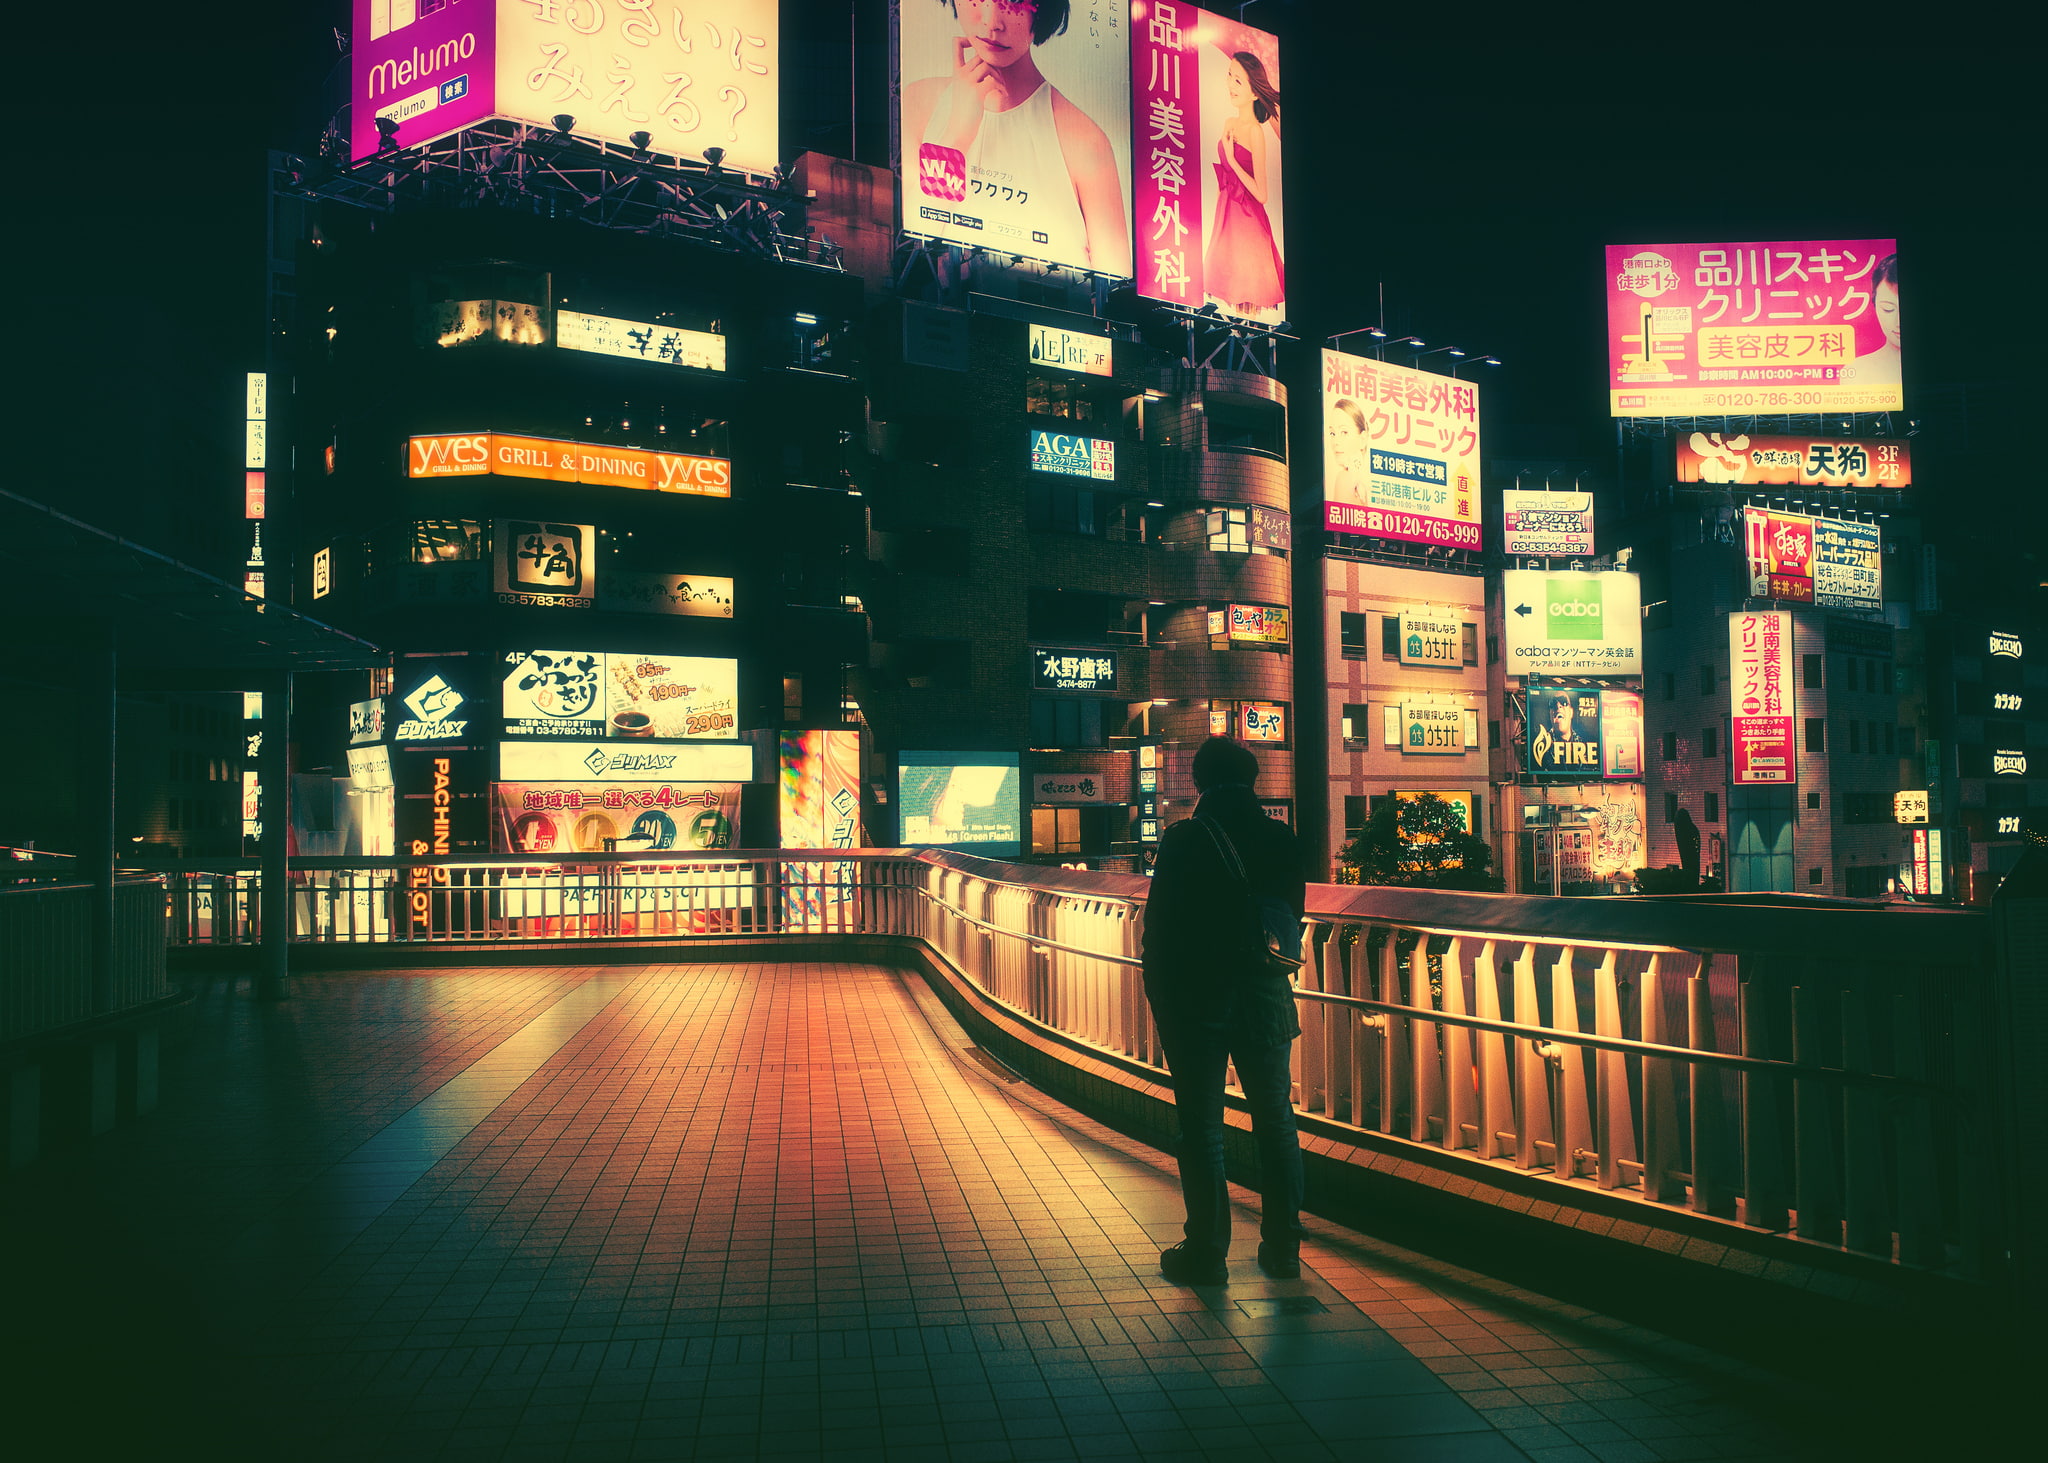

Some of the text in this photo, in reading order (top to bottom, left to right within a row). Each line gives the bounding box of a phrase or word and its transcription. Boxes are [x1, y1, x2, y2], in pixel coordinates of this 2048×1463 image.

[1148, 1, 1191, 297] 品川美容外科
[970, 179, 1028, 204] ワクワク
[1624, 259, 1671, 269] 港南口より
[1695, 248, 1876, 286] 品川スキン
[1618, 272, 1680, 291] 徒歩1分
[1698, 286, 1870, 323] クリニック
[1708, 332, 1846, 360] 美容皮フ科
[1095, 353, 1105, 366] 7F
[1327, 356, 1475, 423] 湘南美容外科
[1717, 392, 1822, 407] 0120-786-300
[1369, 407, 1477, 457] クリニック
[412, 437, 488, 474] yves
[1032, 432, 1090, 459] AGA
[1878, 446, 1899, 462] 3F
[433, 463, 487, 473] GRILL & DINING
[499, 446, 646, 477] GRILL & DINING
[656, 455, 728, 488] yves
[1040, 454, 1090, 469] スキンクリニック
[1372, 454, 1445, 480] 夜19時まで営業
[1806, 445, 1867, 477] 天狗
[1878, 464, 1900, 480] 2F
[676, 482, 696, 491] GRILL
[1371, 480, 1447, 504] 三和港南ビル 3F
[1457, 475, 1469, 516] 直進
[1329, 506, 1367, 528] 品川院
[1385, 513, 1479, 545] 0120-765-999
[1774, 521, 1807, 561] すき家
[518, 536, 574, 579] 牛角
[1772, 579, 1811, 597] 牛丼・カレー
[499, 594, 591, 609] 03-5783-4329
[1407, 620, 1457, 635] お部屋探しなら
[505, 652, 526, 664] 4F
[1741, 616, 1759, 696] クリニック
[1990, 636, 2023, 657] BIG ECHO
[1043, 656, 1113, 680] 水野歯科
[1762, 615, 1782, 715] 湘南美容外科
[1994, 693, 2023, 711] カラオケ
[686, 713, 734, 734] 290円
[1247, 706, 1281, 737] 包丁や
[1409, 709, 1459, 722] お部屋探しなら
[1554, 742, 1598, 765] FIRE
[1993, 755, 2026, 775] BIG ECHO
[524, 785, 719, 810] 地域唯一 選べる4レート
[1900, 800, 1926, 811] 天狗
[413, 840, 428, 855] &
